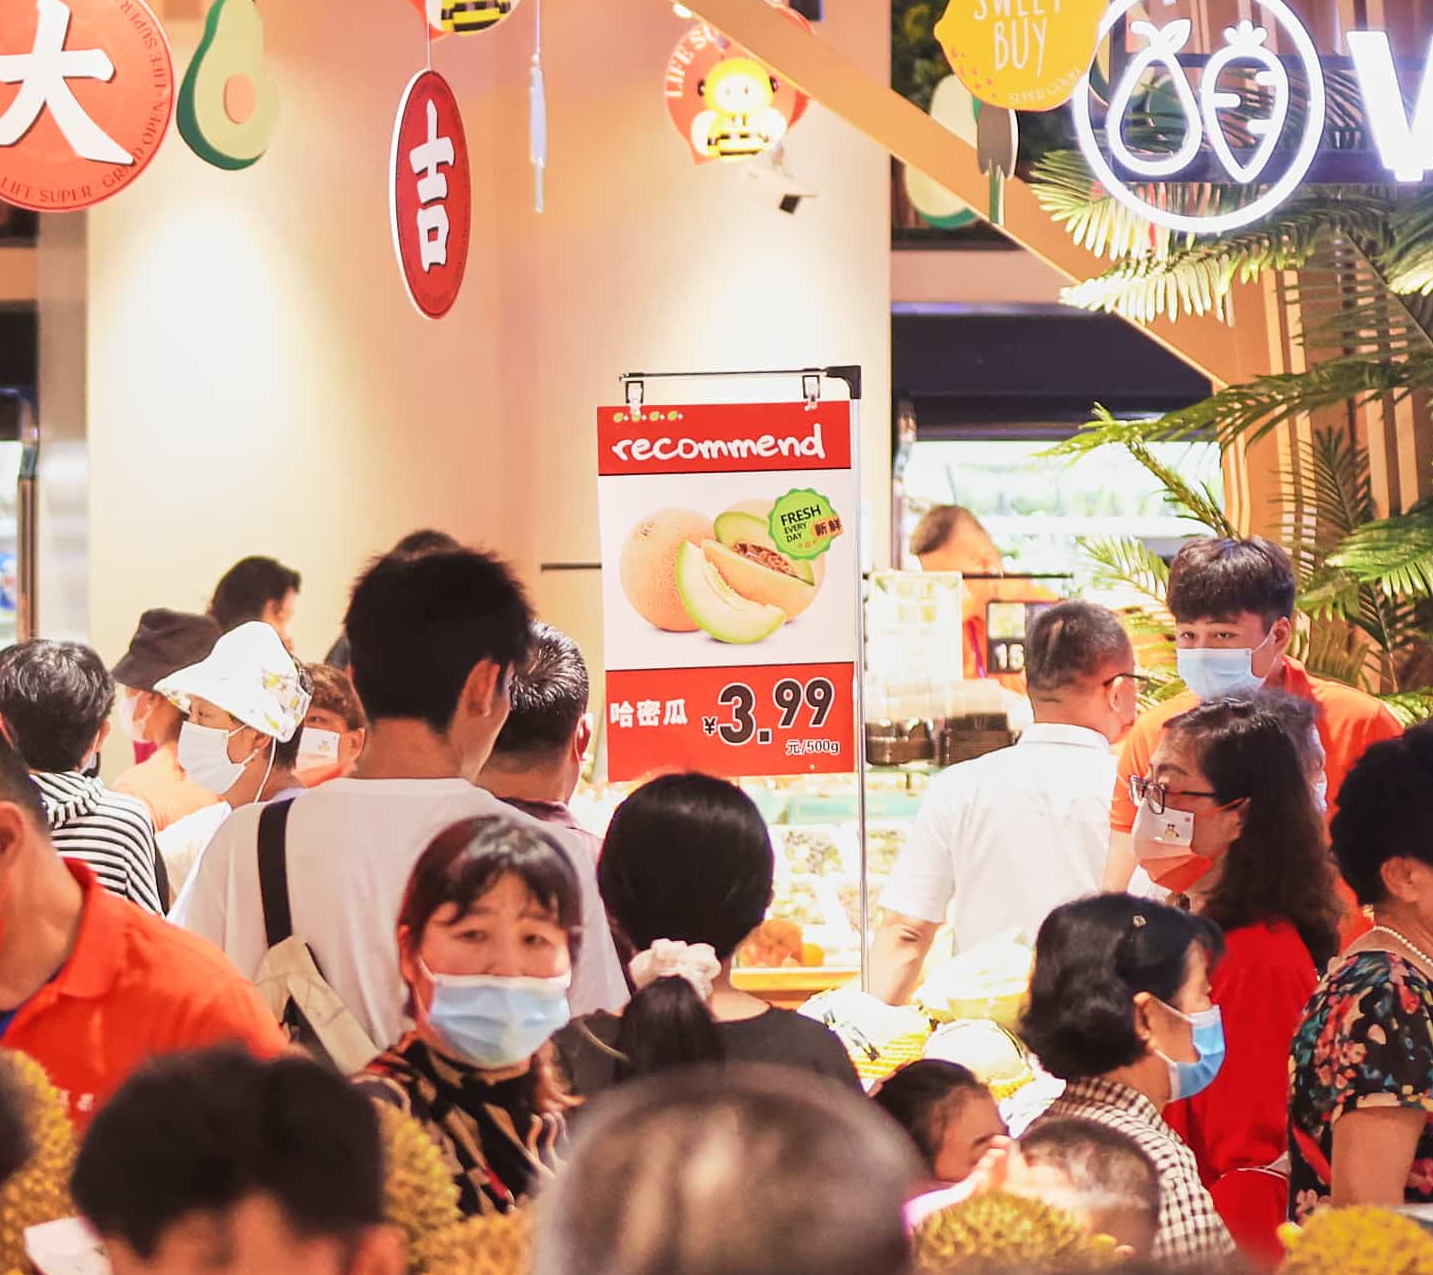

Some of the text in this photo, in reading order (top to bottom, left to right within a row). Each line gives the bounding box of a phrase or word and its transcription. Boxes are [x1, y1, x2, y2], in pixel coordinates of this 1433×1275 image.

[993, 18, 1048, 78] BUY
[665, 45, 694, 97] LIFE
[410, 98, 455, 272] 吉
[611, 423, 825, 462] recommend
[781, 504, 821, 526] FRESH
[784, 522, 807, 534] EVERY
[786, 533, 802, 543] DAY
[610, 699, 687, 728] 哈密瓜
[786, 739, 840, 755] 元/500g
